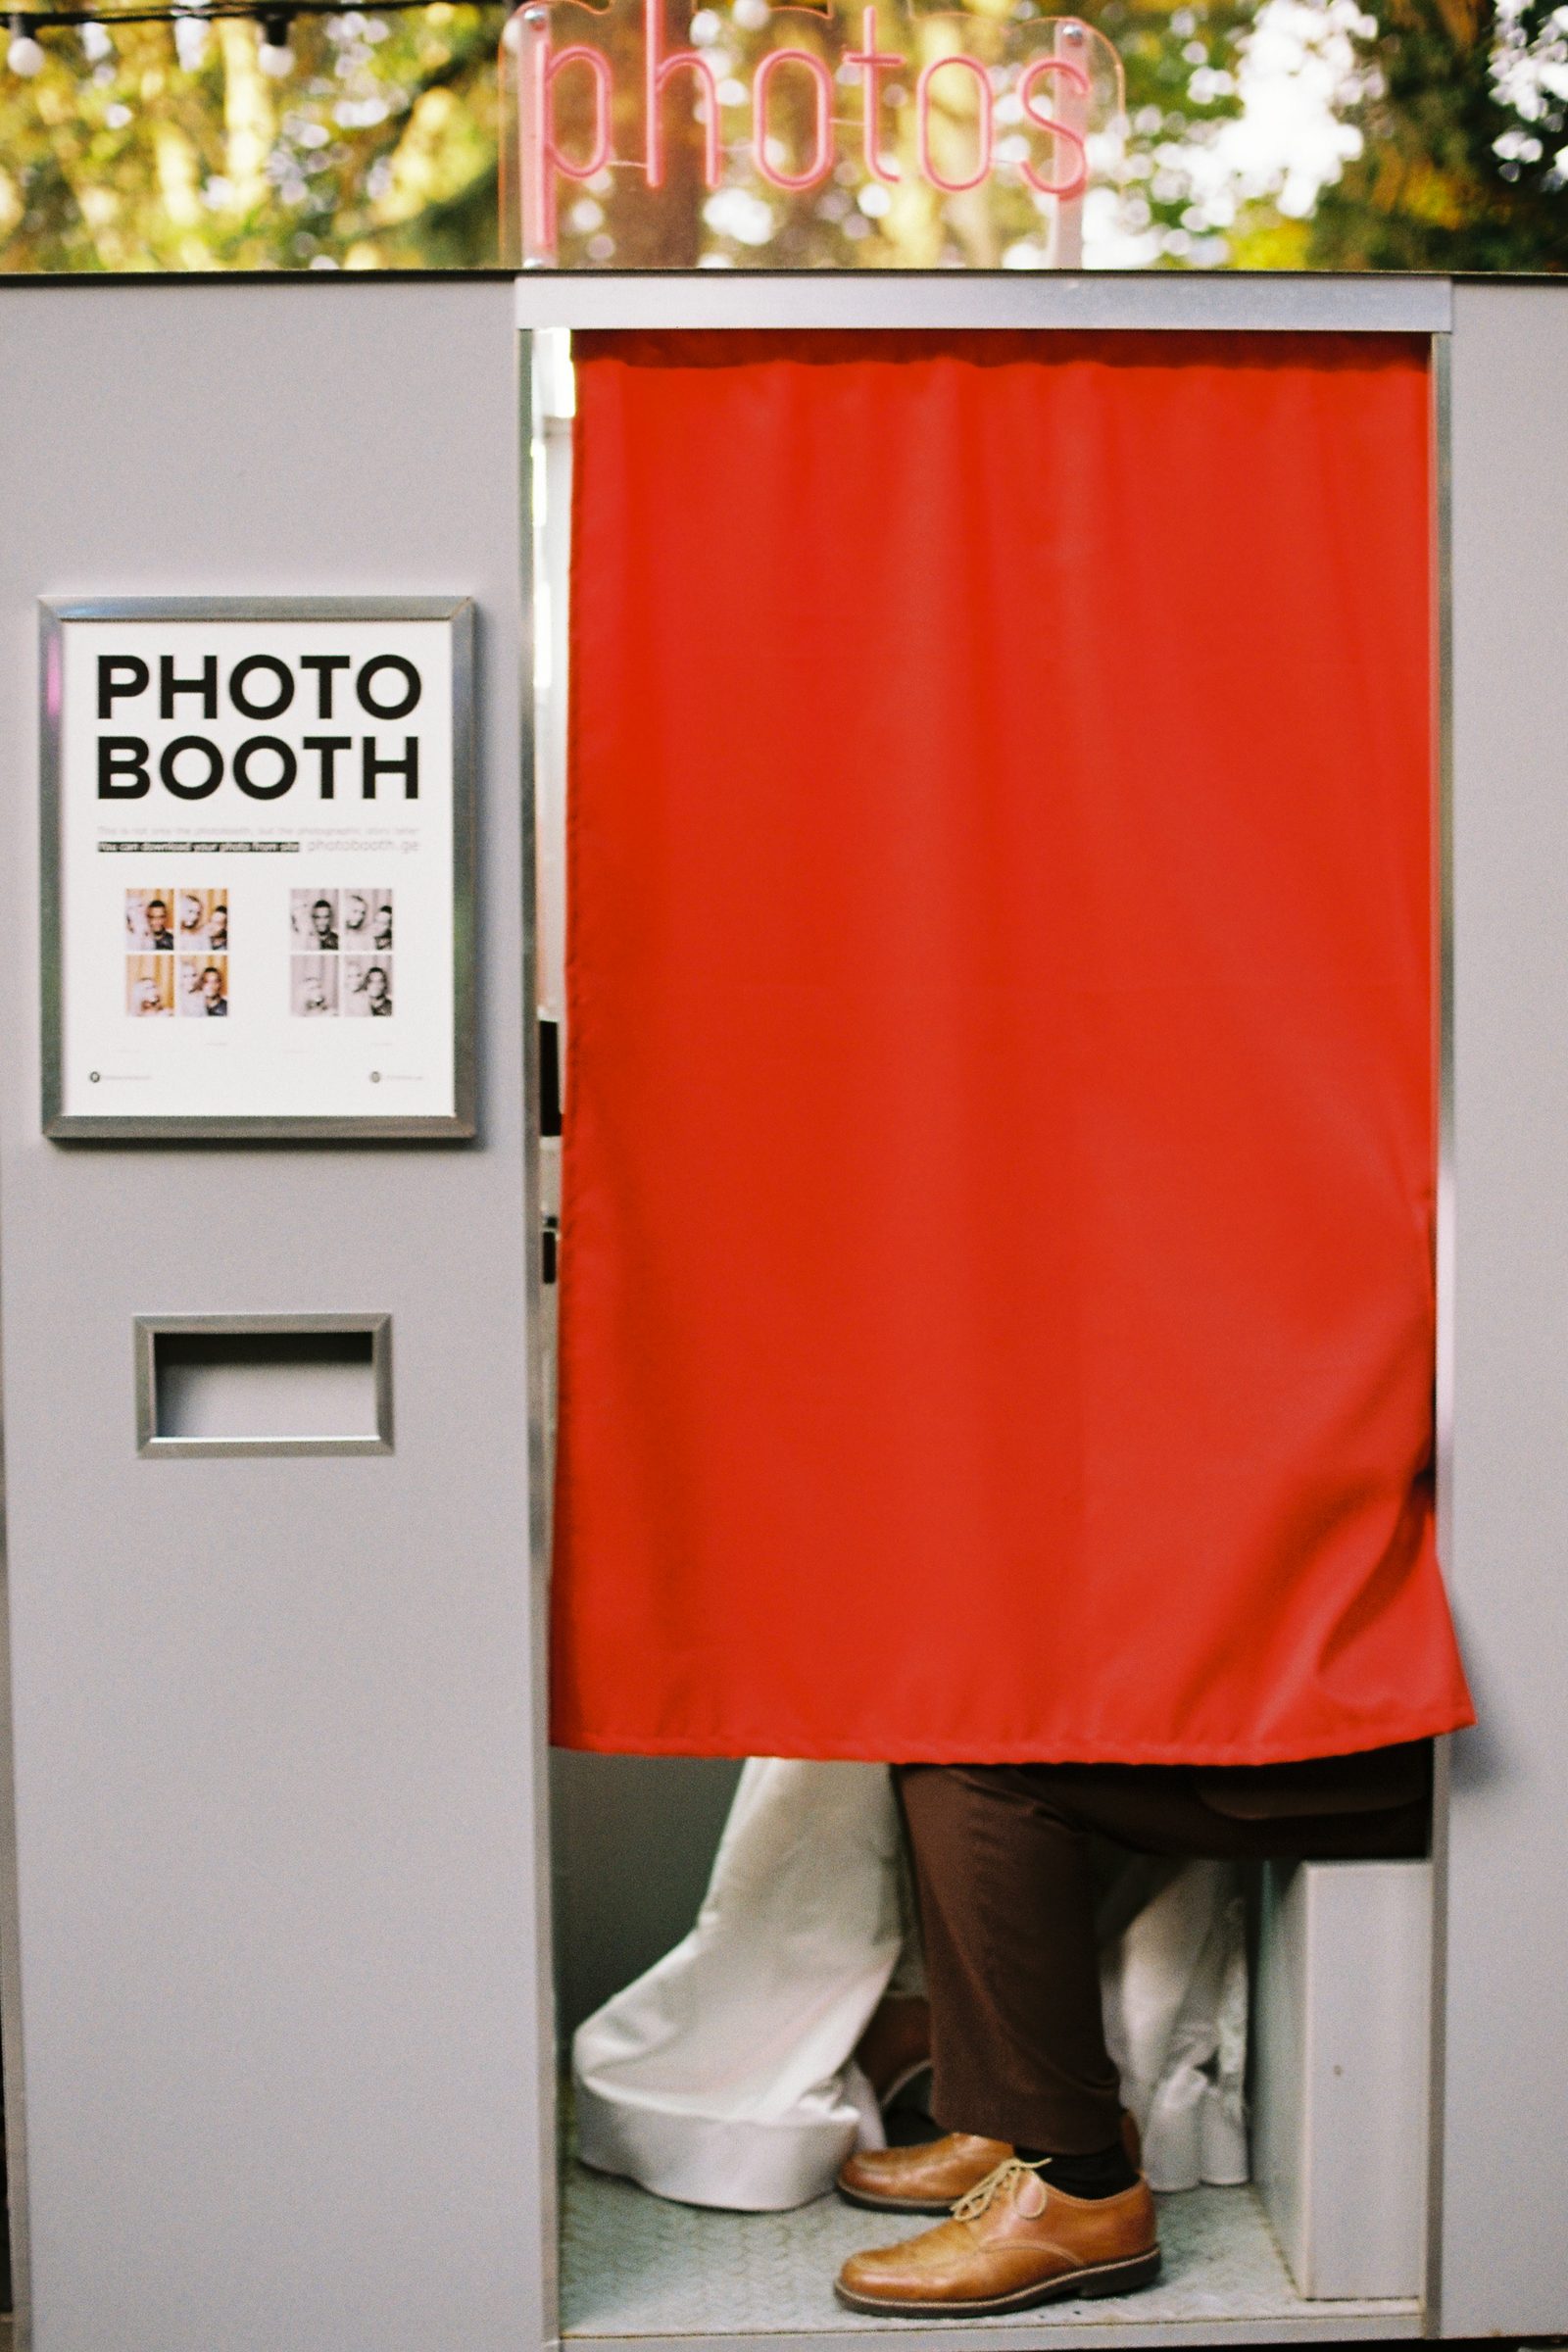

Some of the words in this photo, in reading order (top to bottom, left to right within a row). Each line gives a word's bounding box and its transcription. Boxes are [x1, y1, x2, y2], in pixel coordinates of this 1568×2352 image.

[534, 0, 1094, 251] photos
[97, 654, 422, 721] PHOTO
[97, 735, 419, 801] BOOTH
